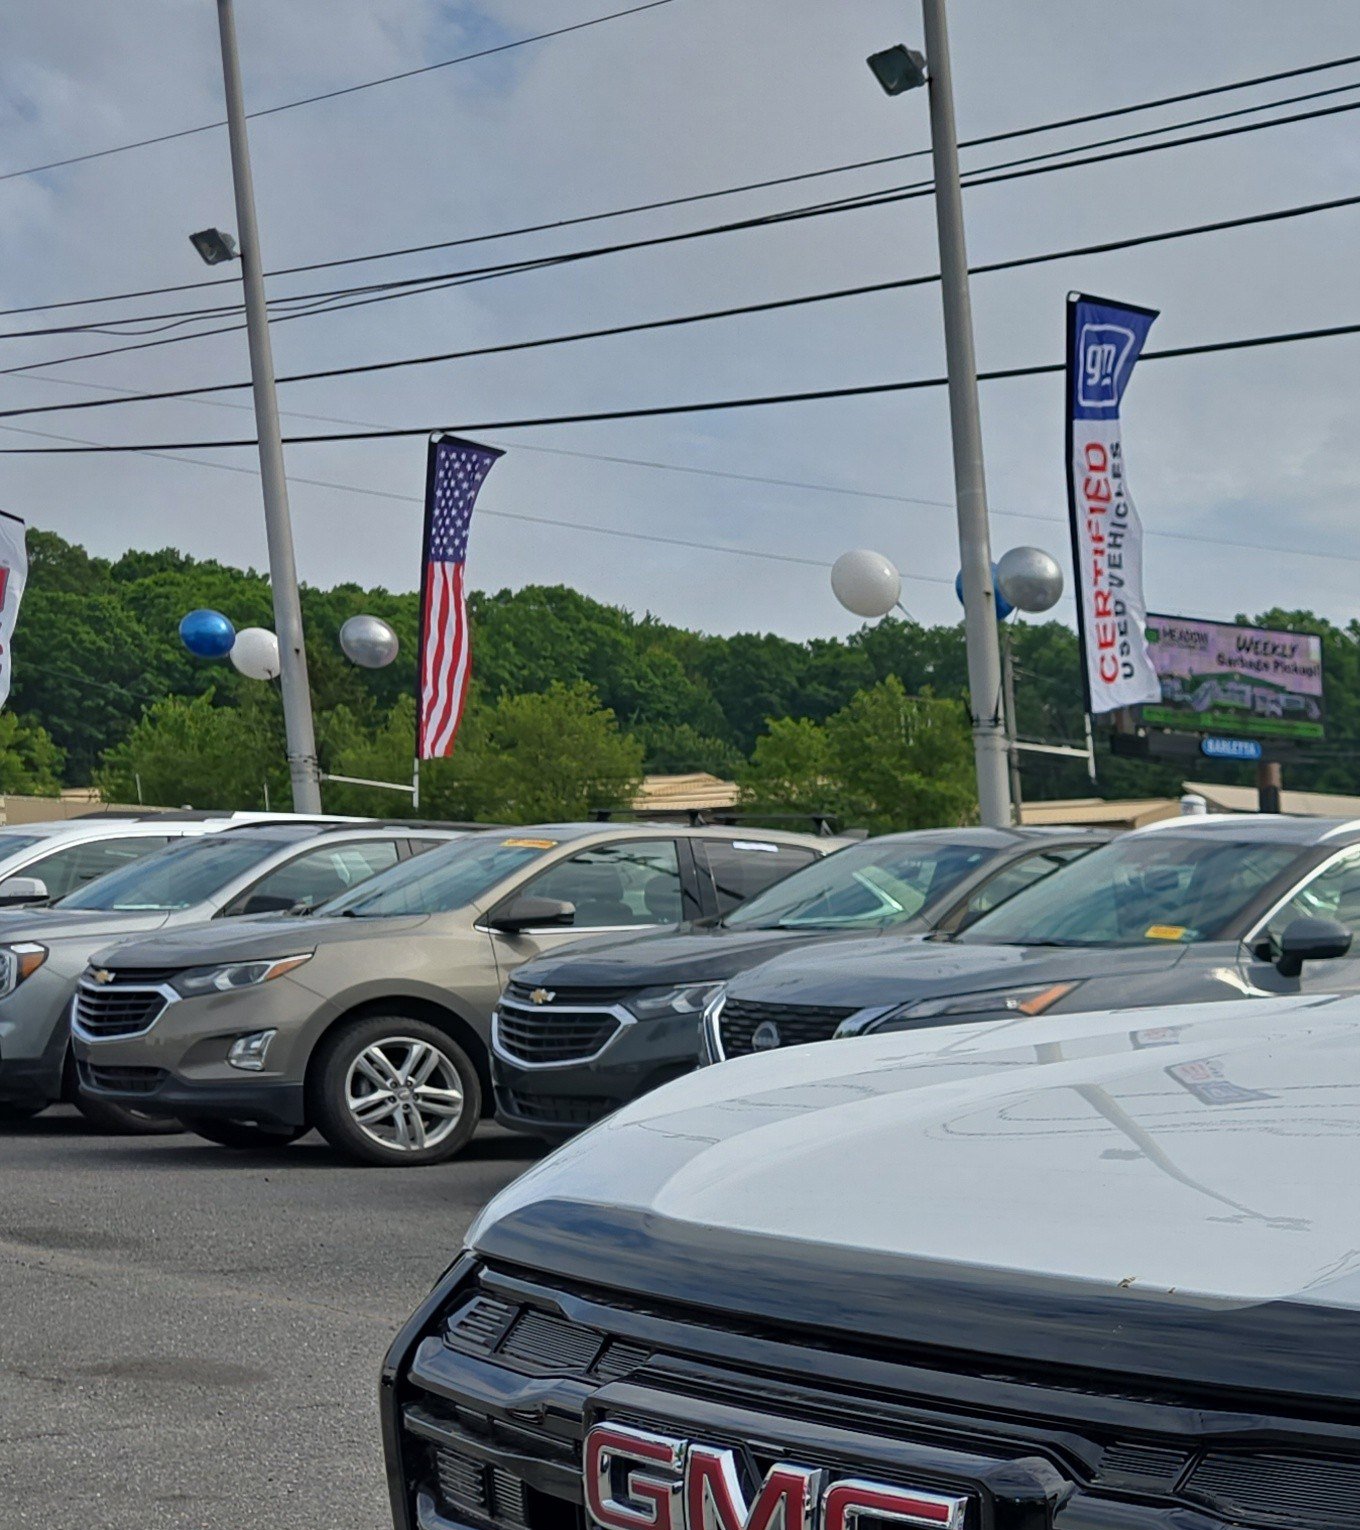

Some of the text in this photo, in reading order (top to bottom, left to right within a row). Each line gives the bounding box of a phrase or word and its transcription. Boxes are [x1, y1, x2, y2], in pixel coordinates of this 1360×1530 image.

[1083, 442, 1119, 685] CERTIFIED
[1114, 600, 1135, 680] USED
[1236, 634, 1298, 659] WEEKLY
